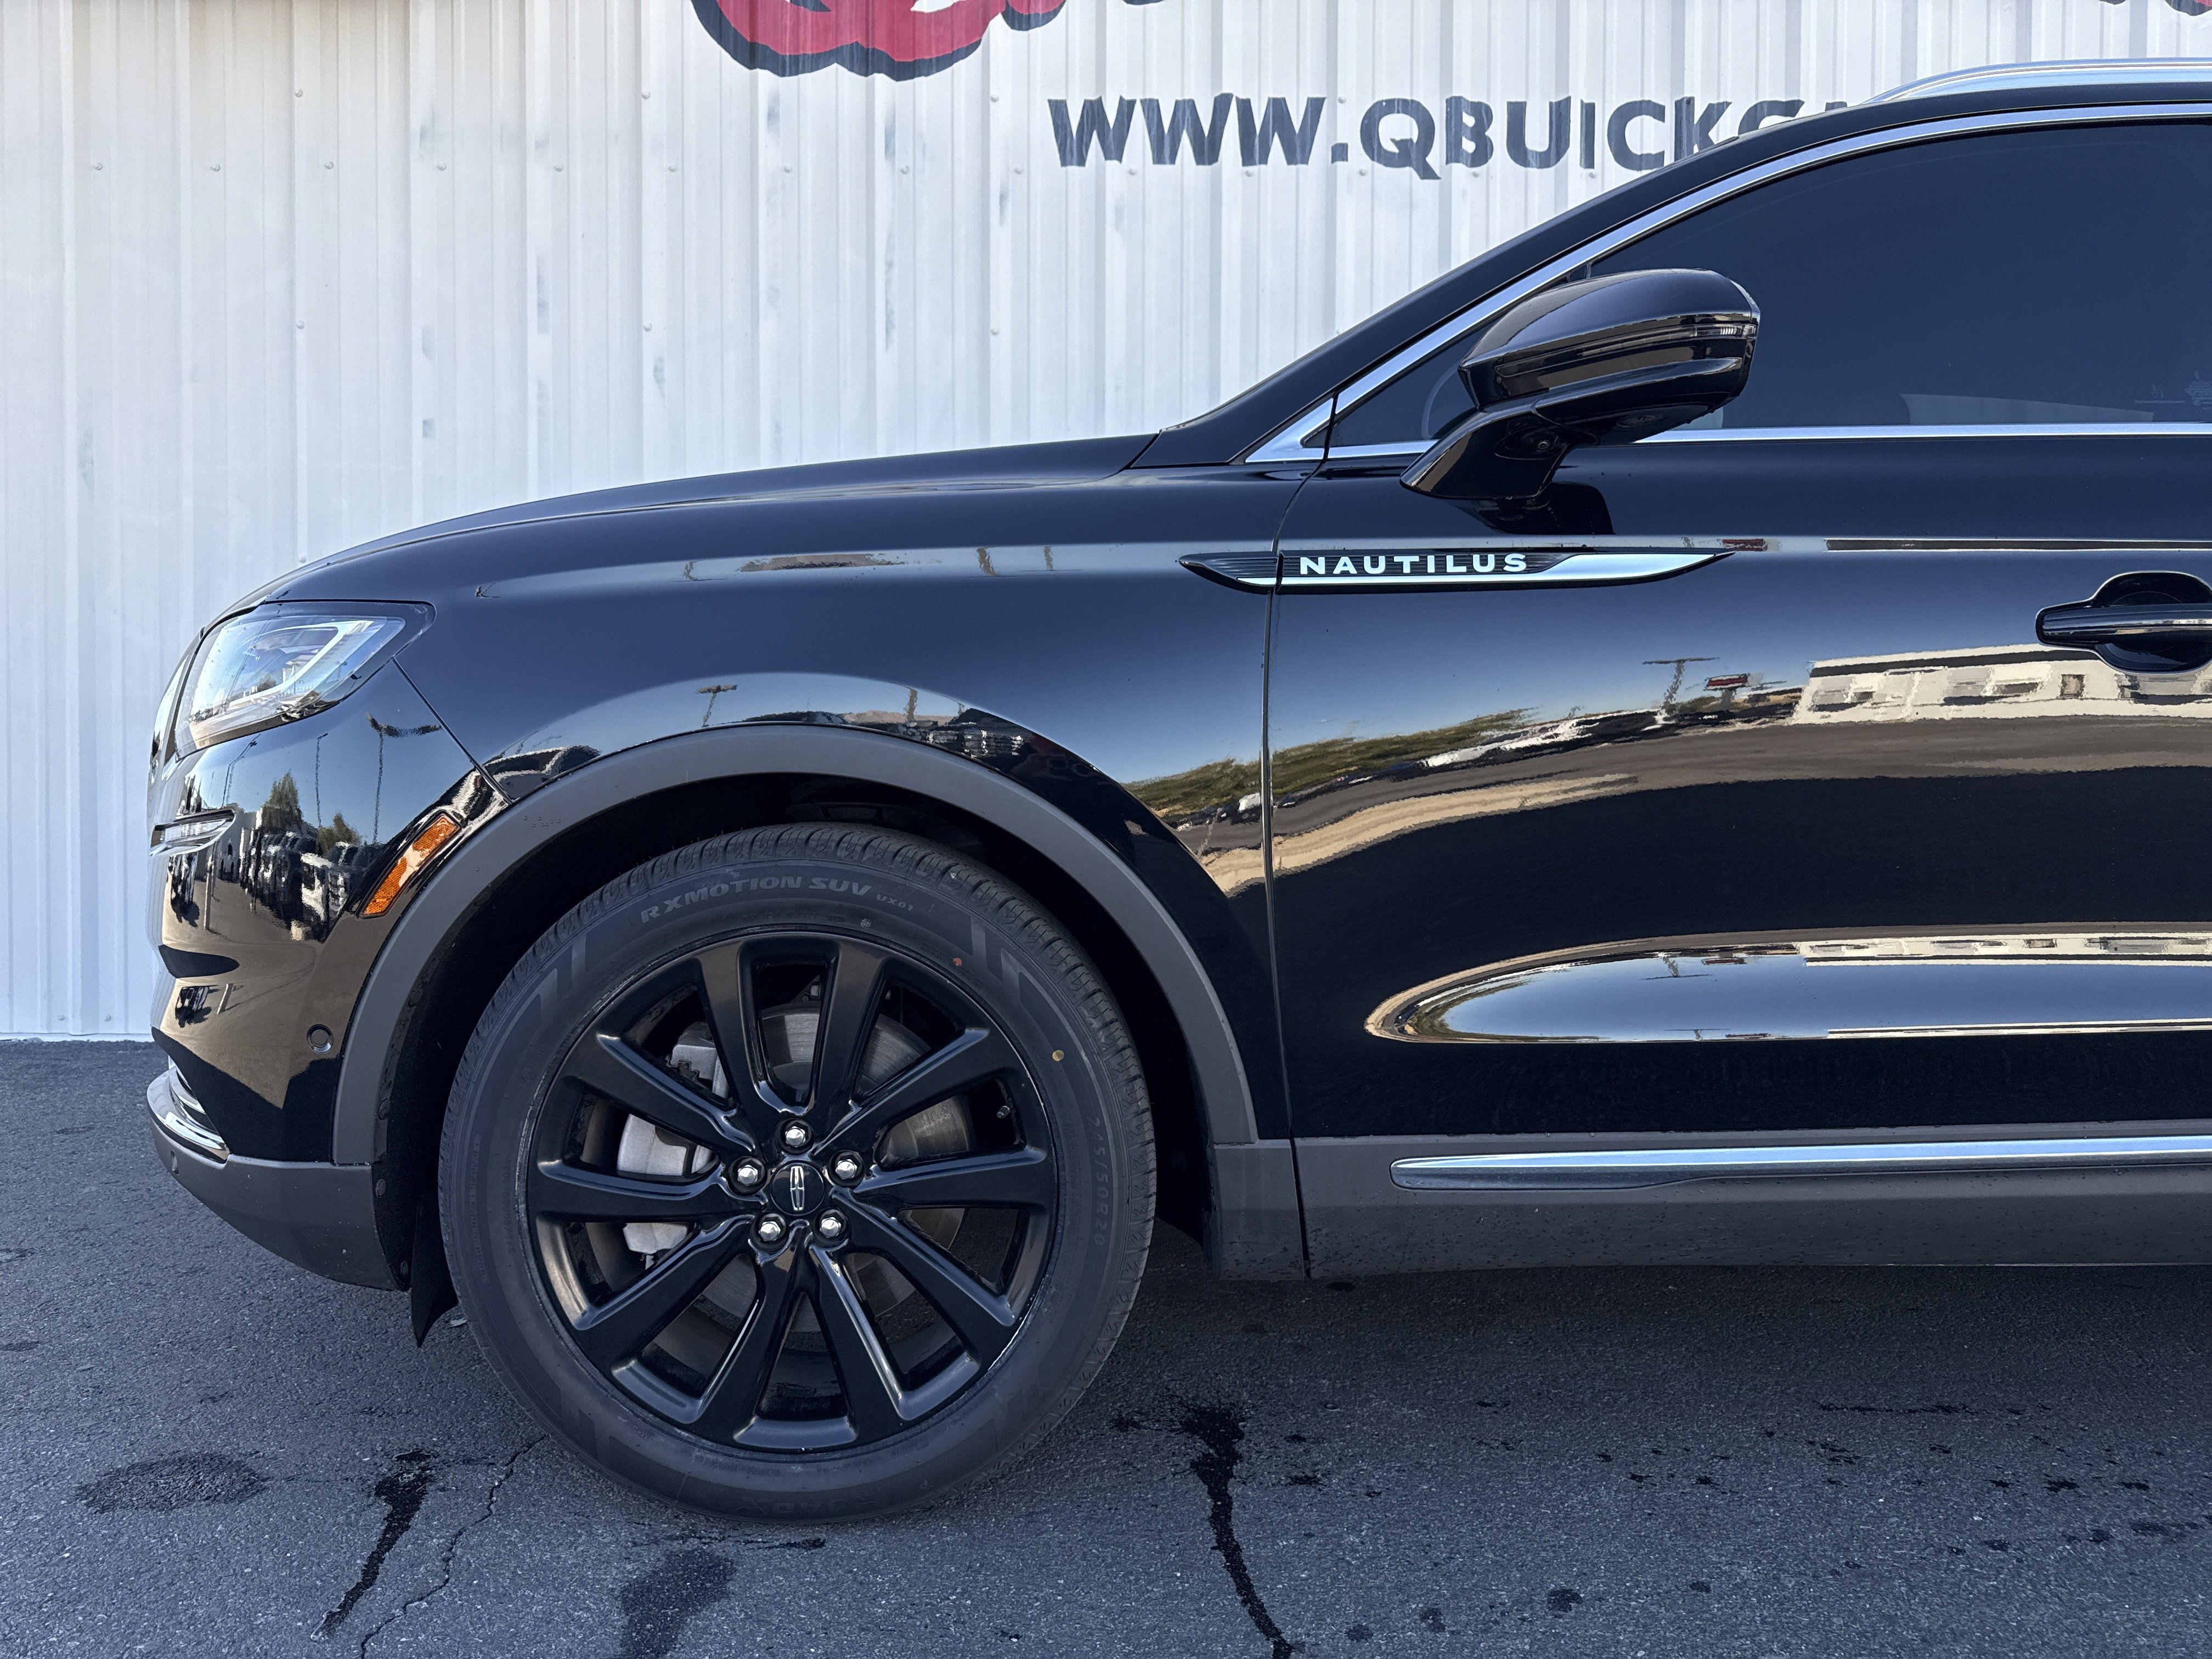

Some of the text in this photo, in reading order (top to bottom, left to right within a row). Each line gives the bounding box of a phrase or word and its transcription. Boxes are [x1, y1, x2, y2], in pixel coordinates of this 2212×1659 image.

[1047, 92, 1850, 180] WWW.QBUICK
[1300, 553, 1527, 575] NAUTILUS
[640, 876, 802, 924] RXMOTION
[808, 876, 872, 896] SUV
[876, 894, 914, 912] UX01
